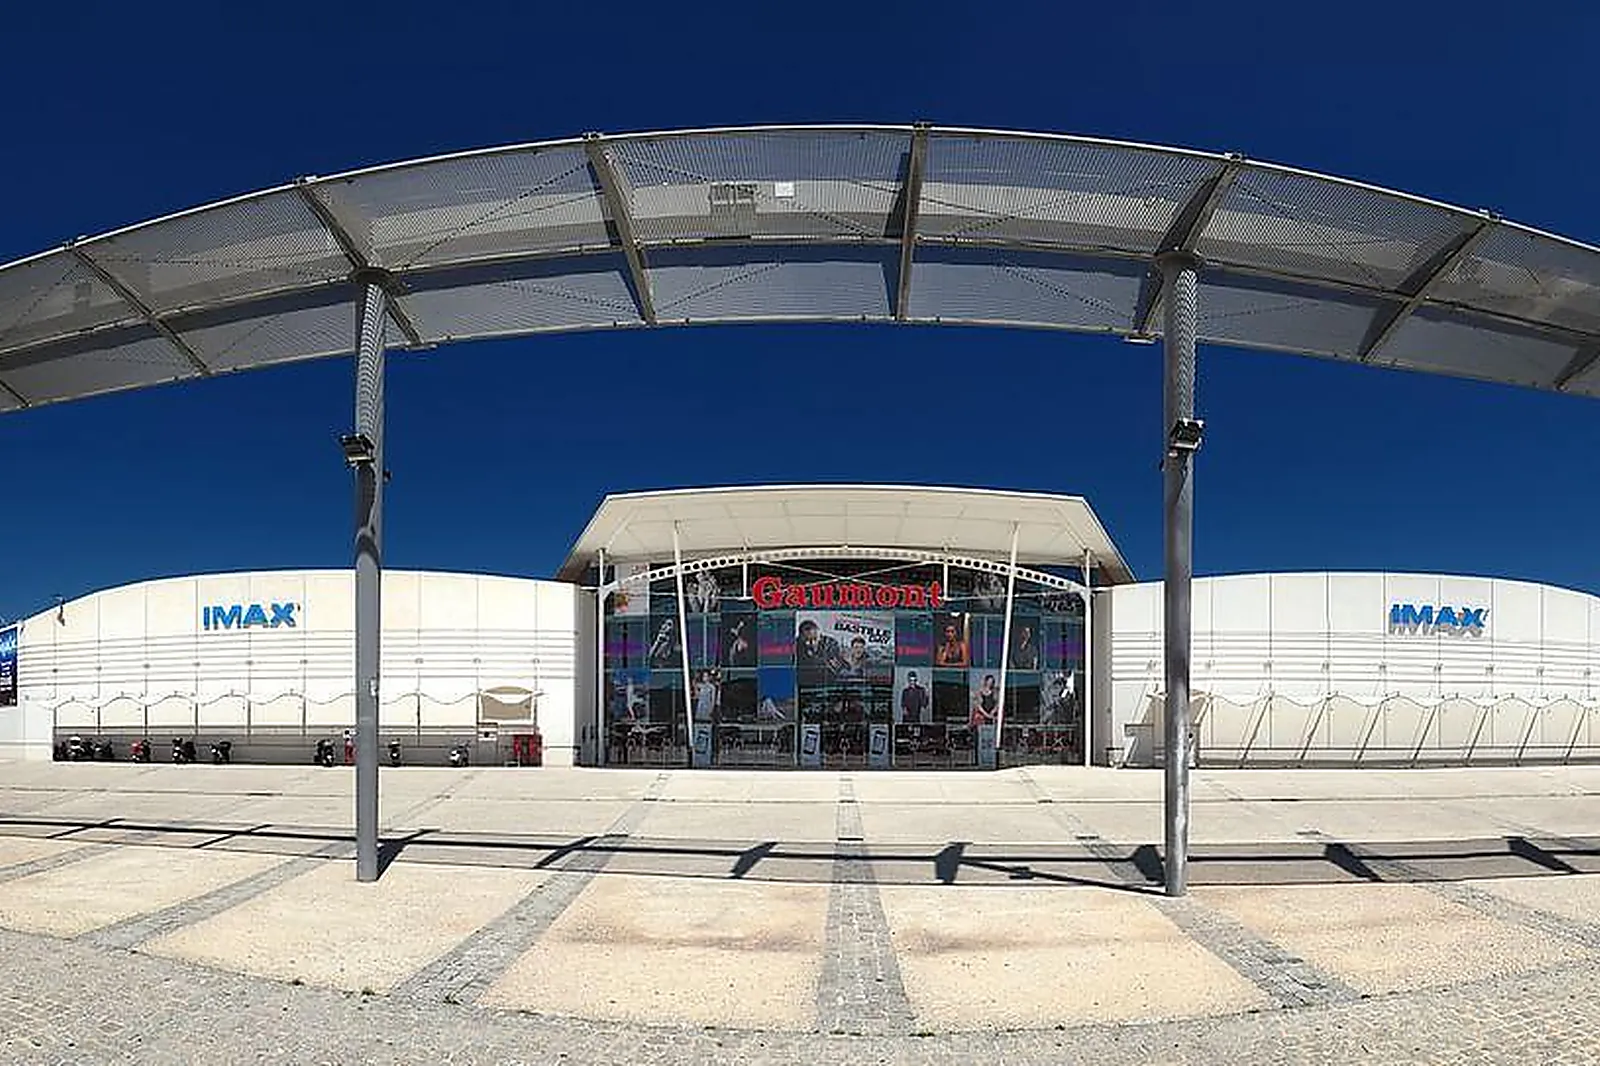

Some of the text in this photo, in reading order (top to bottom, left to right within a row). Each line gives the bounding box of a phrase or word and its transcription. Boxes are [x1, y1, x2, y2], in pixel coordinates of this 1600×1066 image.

[752, 575, 942, 608] Gaumont
[203, 602, 297, 630] IMAX
[1389, 603, 1486, 629] IMAX
